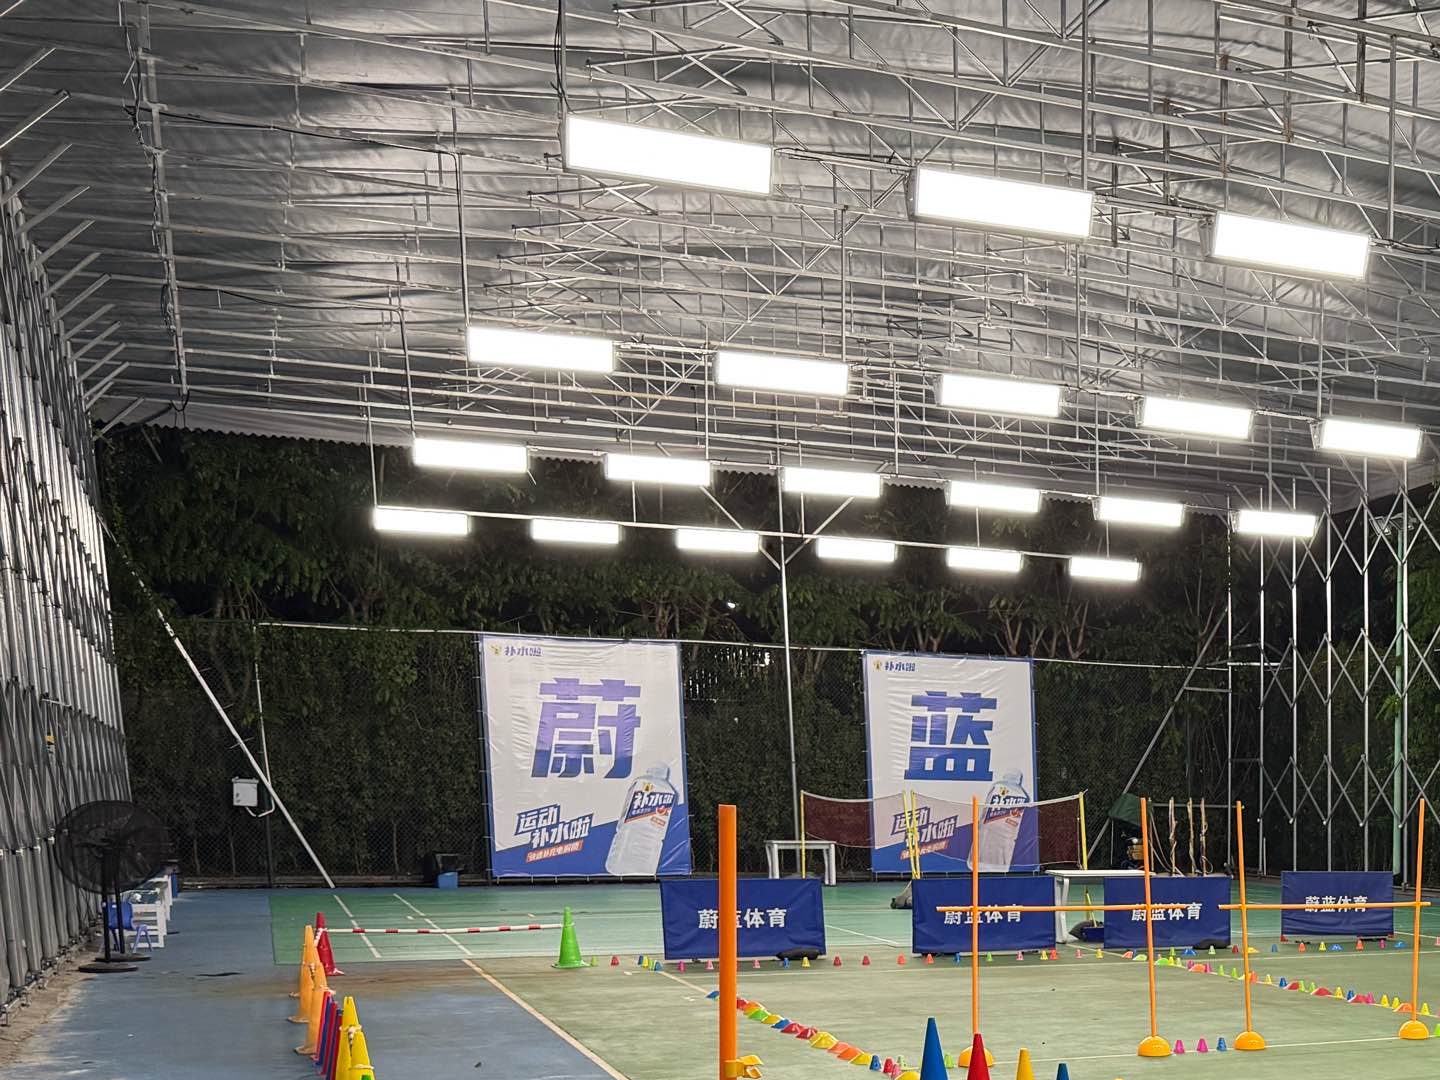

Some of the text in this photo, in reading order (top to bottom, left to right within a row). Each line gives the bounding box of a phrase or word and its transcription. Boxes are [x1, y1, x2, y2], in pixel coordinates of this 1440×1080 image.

[531, 677, 642, 779] 蔚
[904, 690, 998, 782] 蓝
[518, 805, 559, 833] 运动
[531, 816, 591, 849] 补水啦
